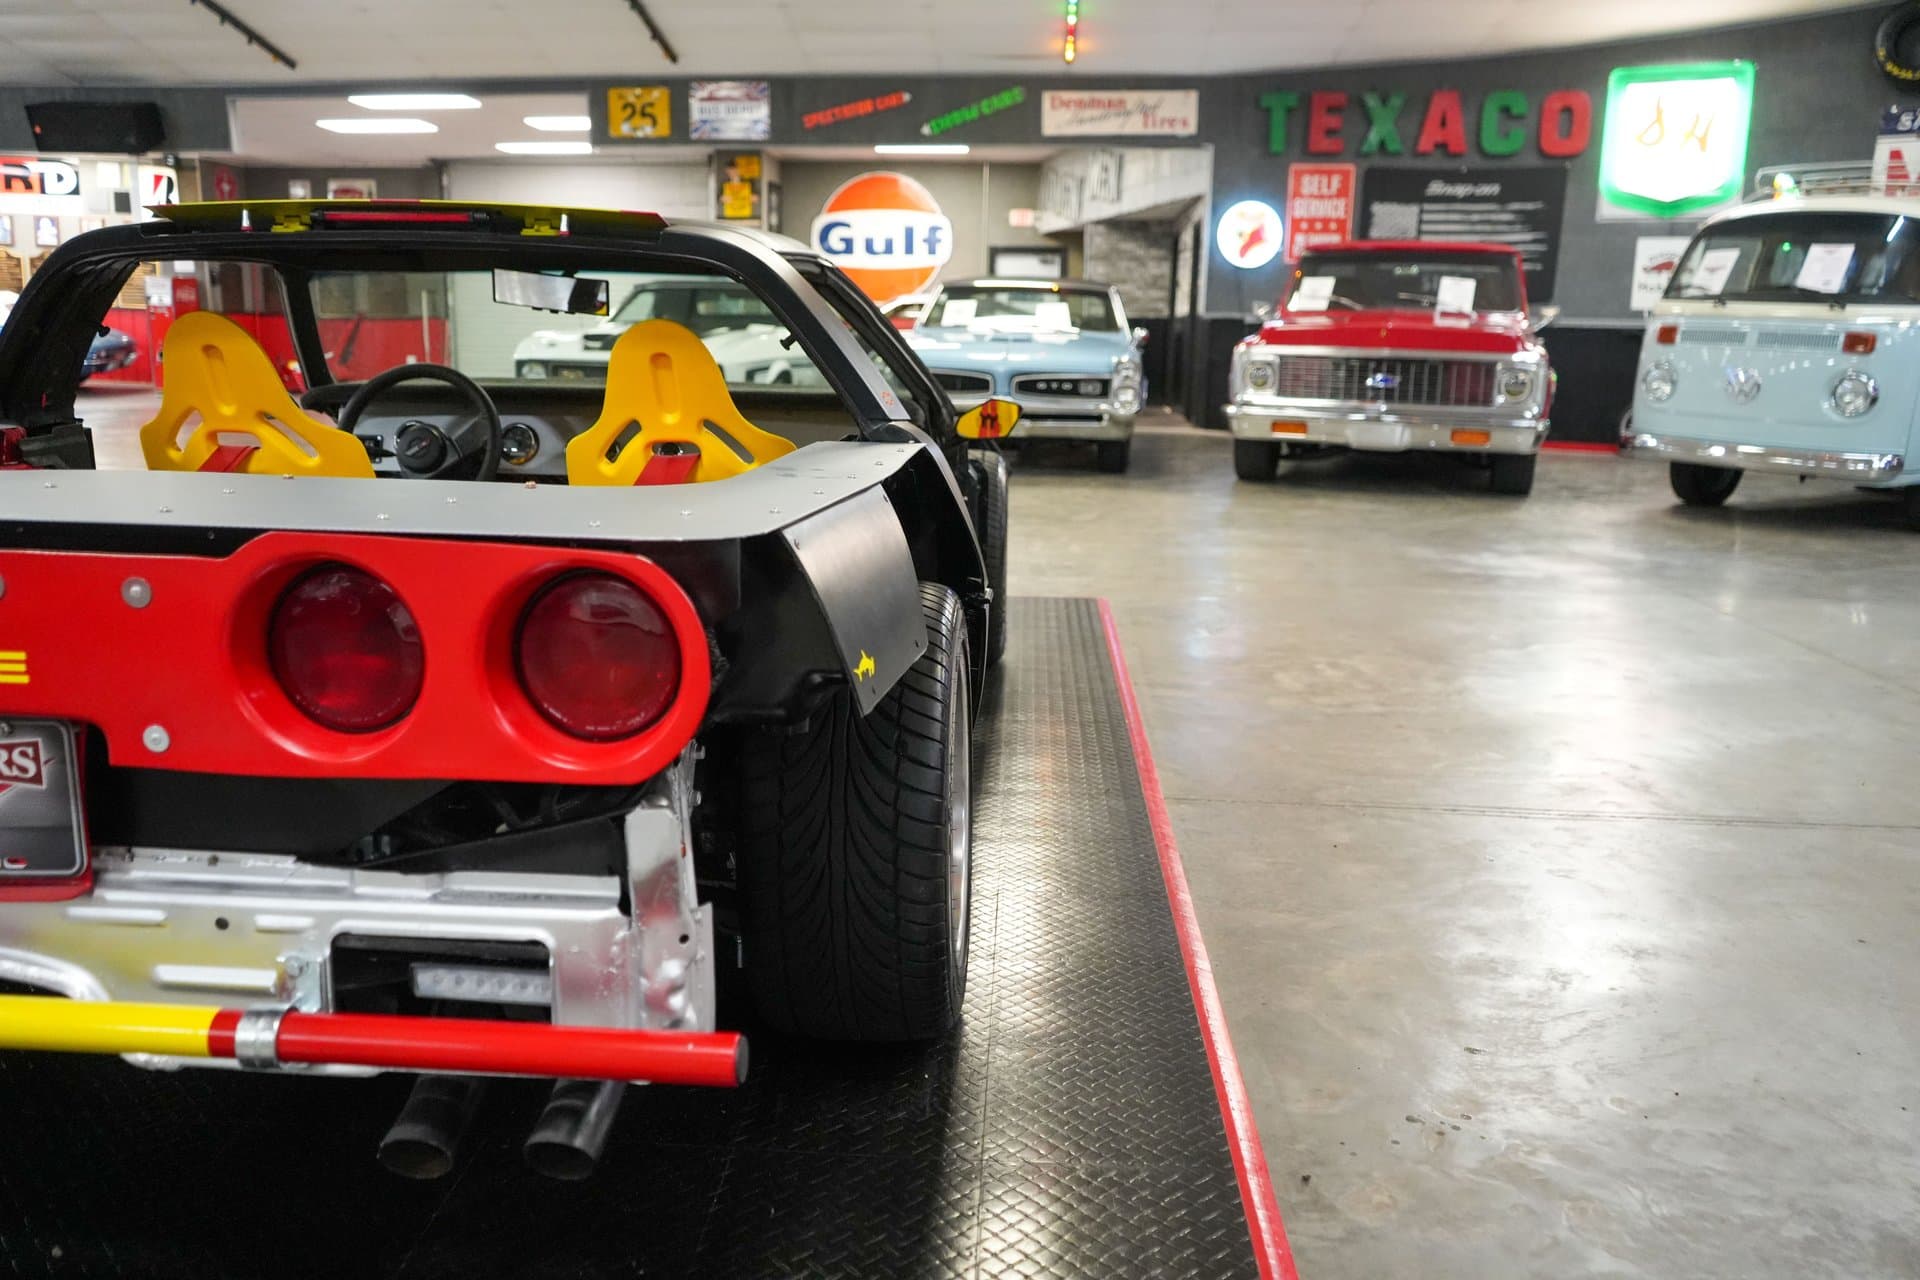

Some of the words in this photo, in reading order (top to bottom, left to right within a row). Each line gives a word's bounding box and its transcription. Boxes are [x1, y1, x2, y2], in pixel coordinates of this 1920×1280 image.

[621, 101, 658, 131] 25
[1258, 90, 1593, 158] TEXACO
[1301, 173, 1344, 196] SELF
[1424, 179, 1502, 199] Snap-on
[1293, 197, 1347, 219] SERVICE
[818, 220, 943, 256] Gulf
